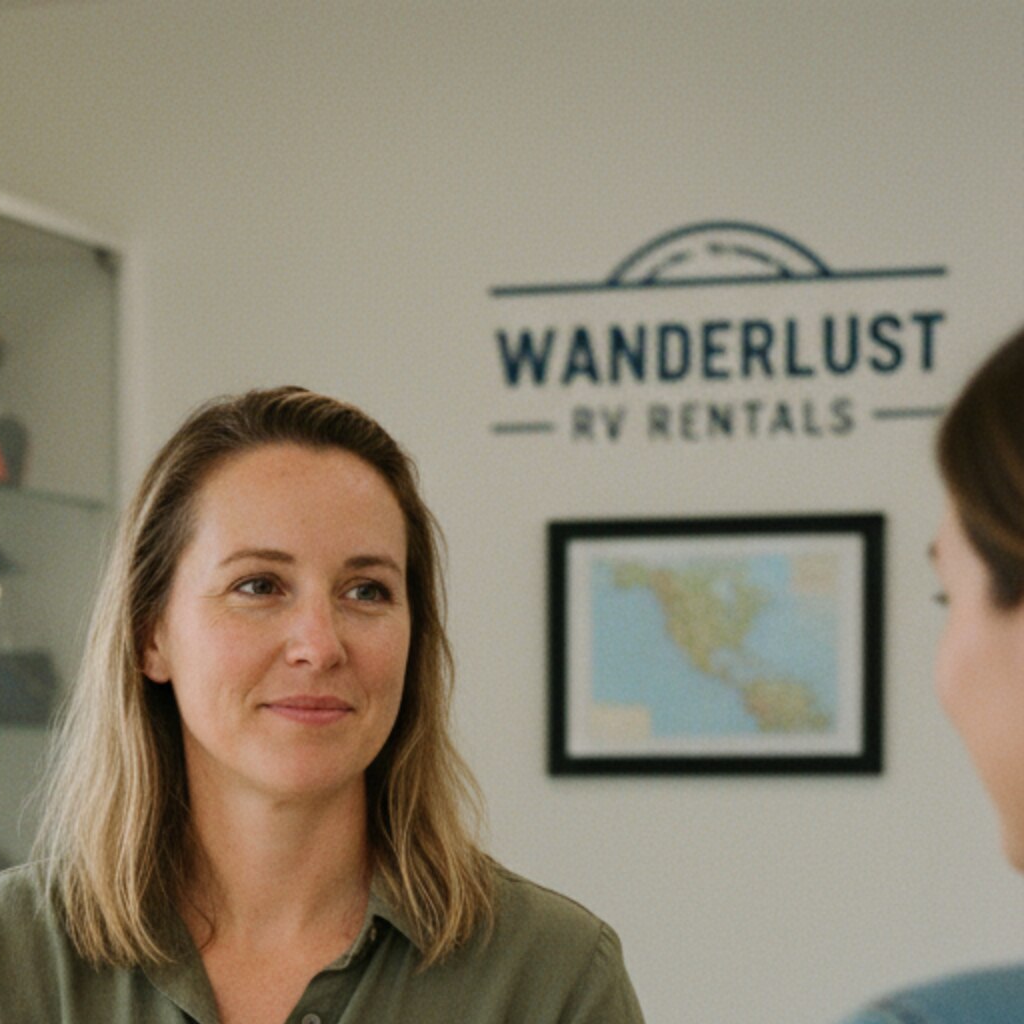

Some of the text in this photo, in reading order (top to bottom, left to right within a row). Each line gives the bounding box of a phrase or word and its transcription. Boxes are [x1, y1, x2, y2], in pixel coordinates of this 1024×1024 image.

[495, 311, 945, 387] WANDERLUST
[571, 398, 856, 442] RV RENTALS
